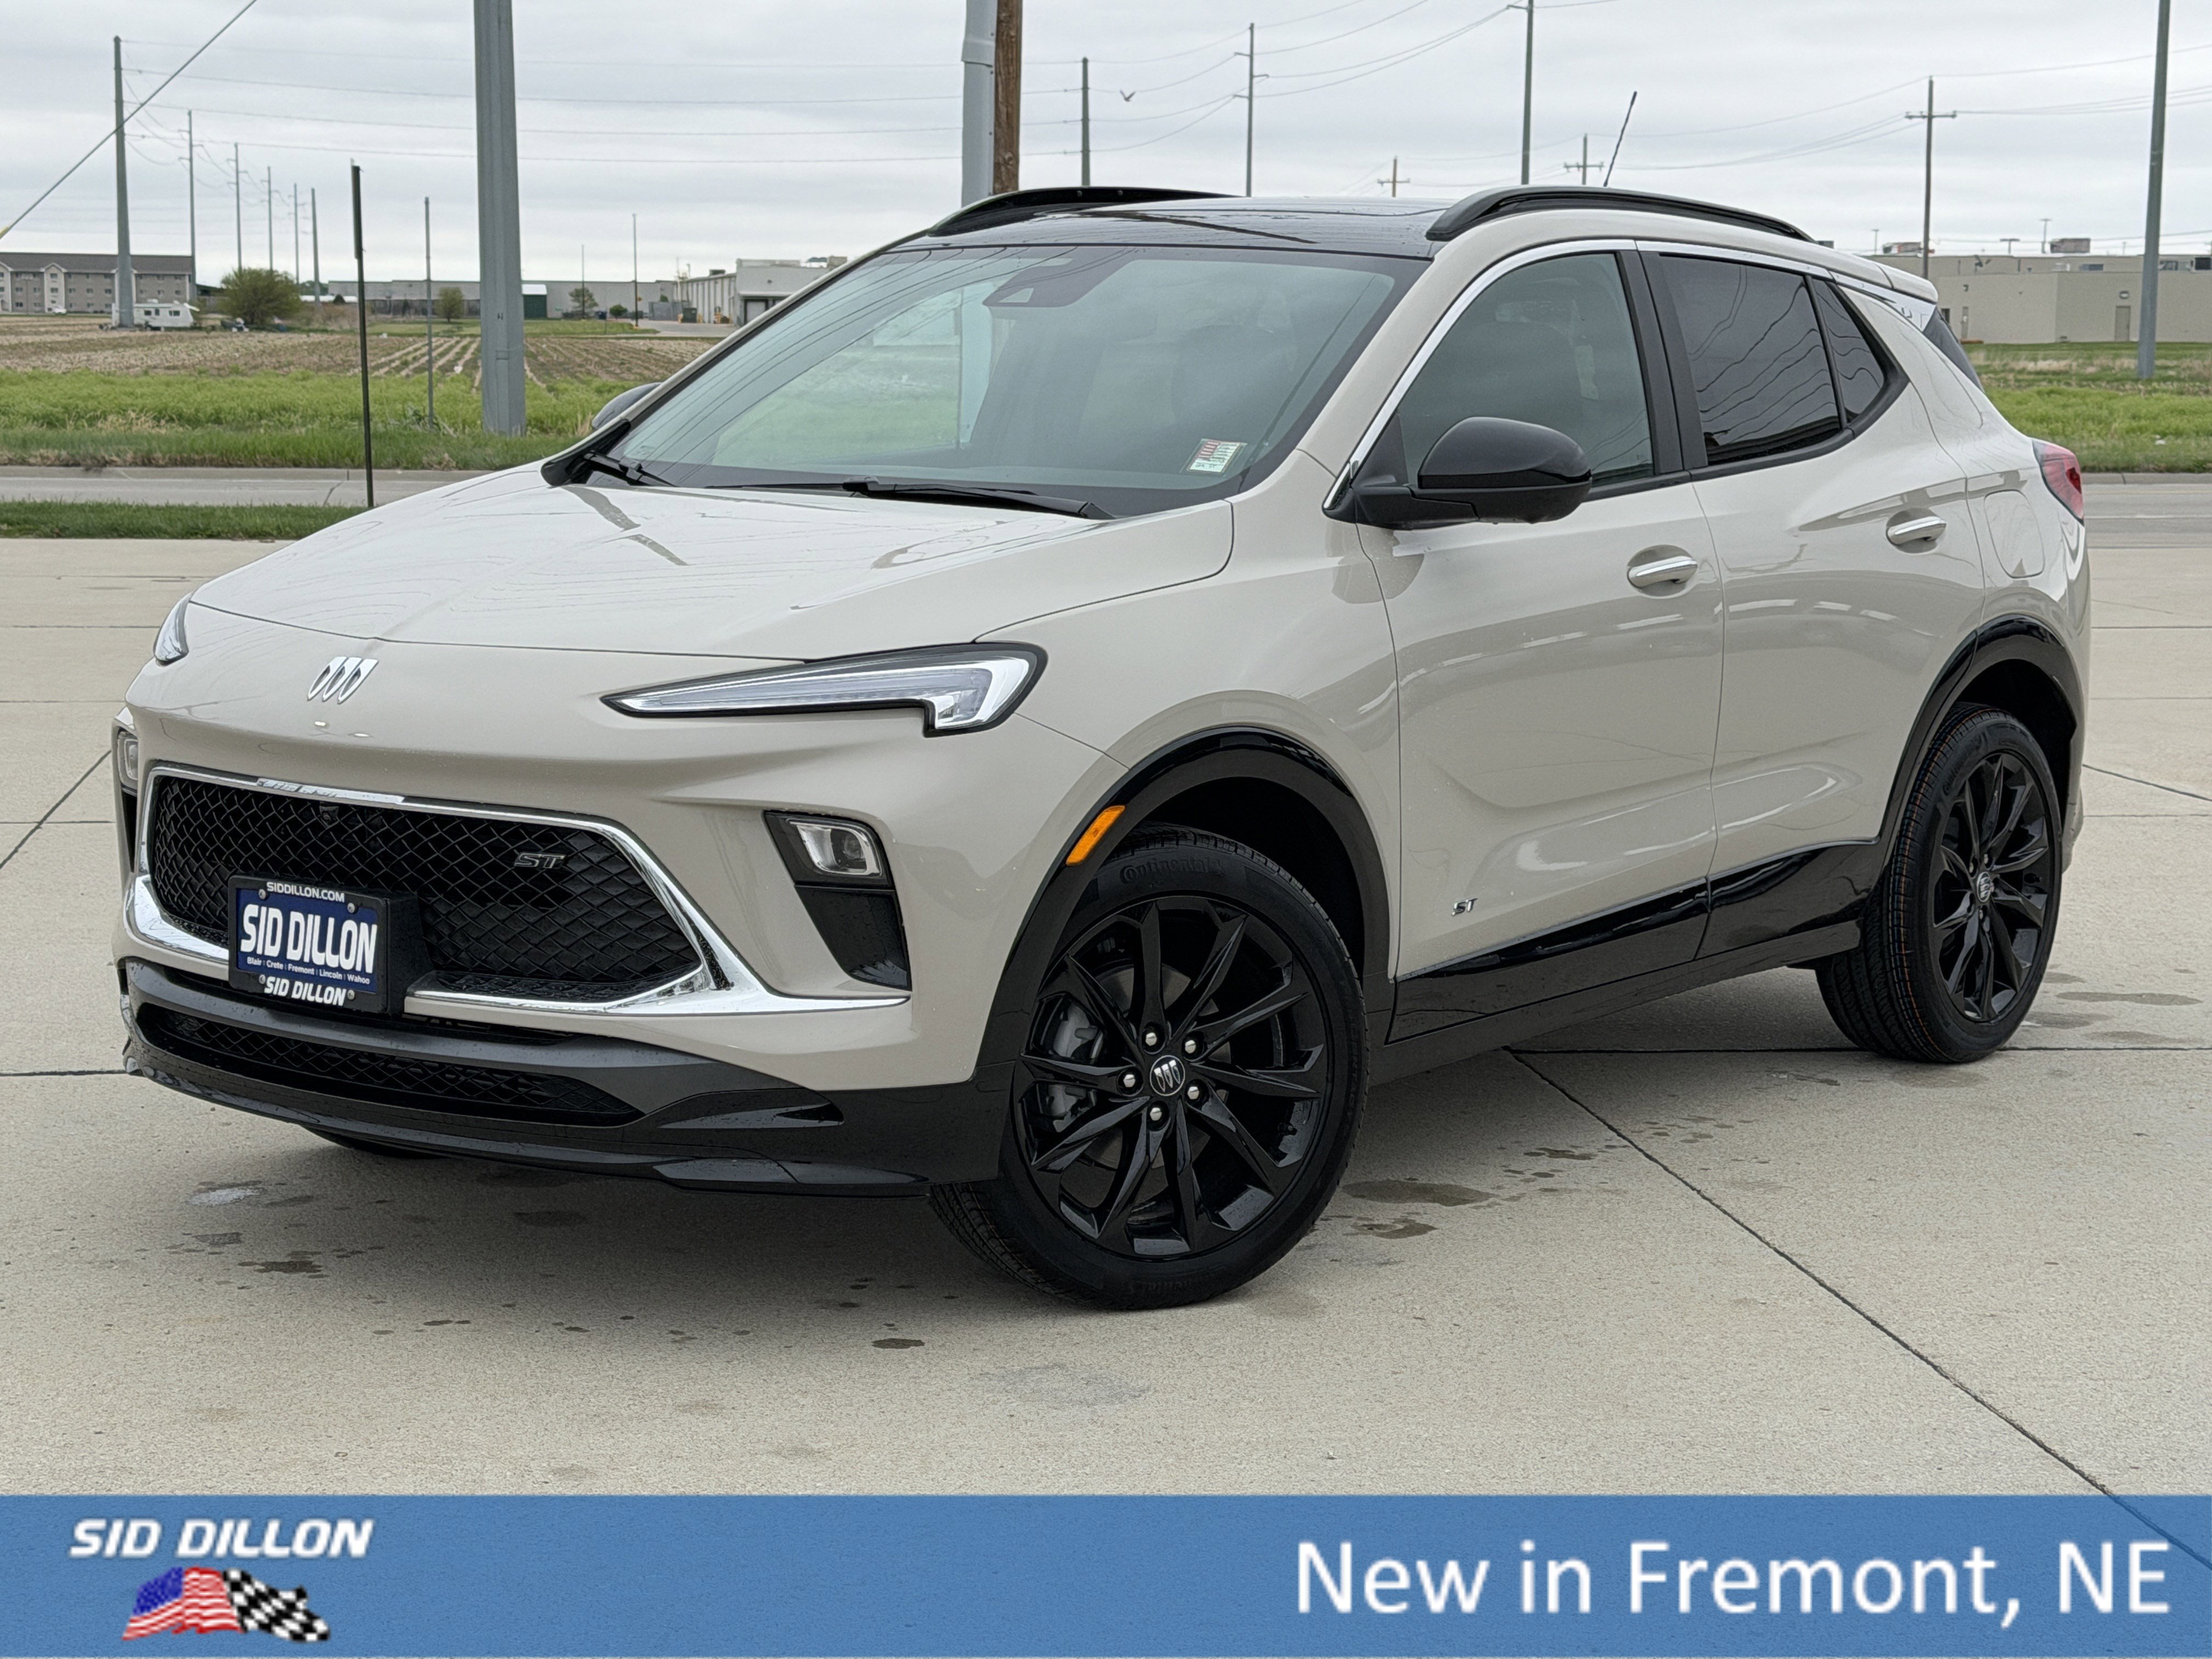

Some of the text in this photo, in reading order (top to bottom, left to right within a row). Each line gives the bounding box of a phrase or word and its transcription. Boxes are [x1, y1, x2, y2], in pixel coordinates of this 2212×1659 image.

[515, 852, 565, 868] ST
[266, 881, 345, 903] SIDDILLON.COM
[1452, 898, 1478, 917] ST
[240, 904, 377, 974] SID DILLON
[247, 957, 370, 985] Blair Crete Fremont Lincoln Wahoo
[264, 976, 347, 1006] SID DILLON
